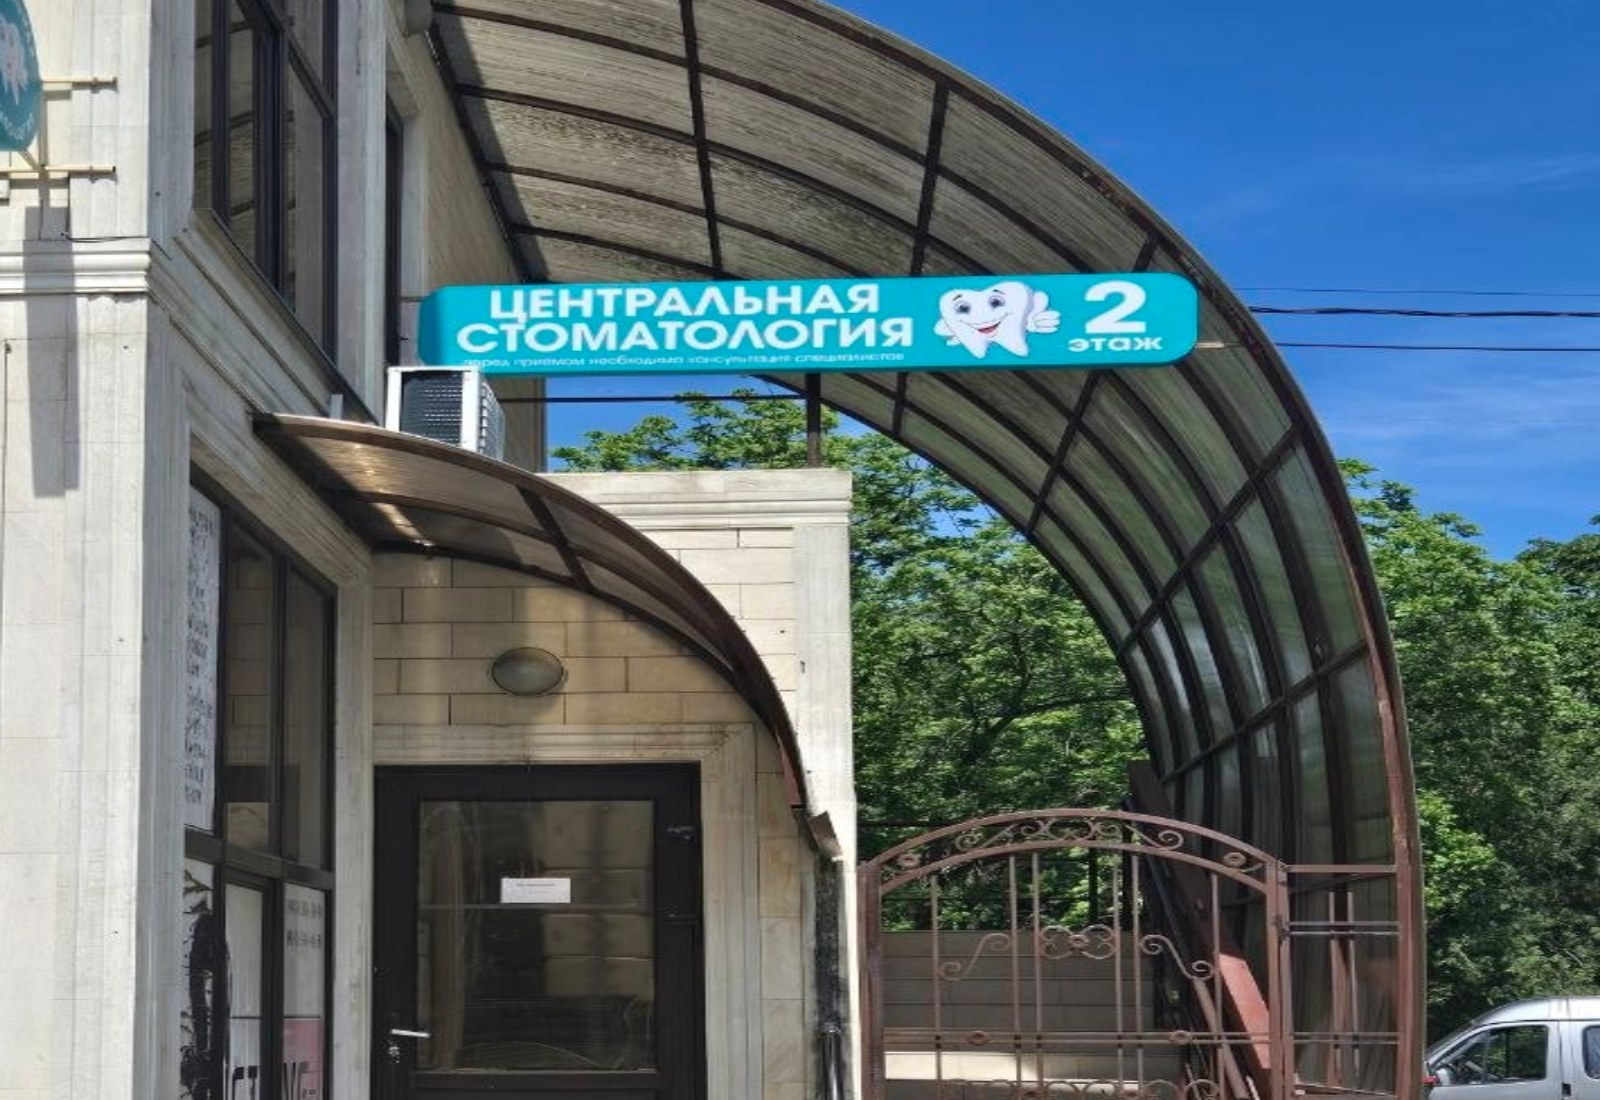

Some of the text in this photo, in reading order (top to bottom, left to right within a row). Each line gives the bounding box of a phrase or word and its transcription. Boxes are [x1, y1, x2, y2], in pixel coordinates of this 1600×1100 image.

[490, 283, 879, 324] ЦЕНТРАЛЬНАЯ
[1085, 280, 1147, 334] 2
[456, 317, 914, 353] СТОМАТОЛОГИЯ
[1067, 336, 1164, 352] этаж
